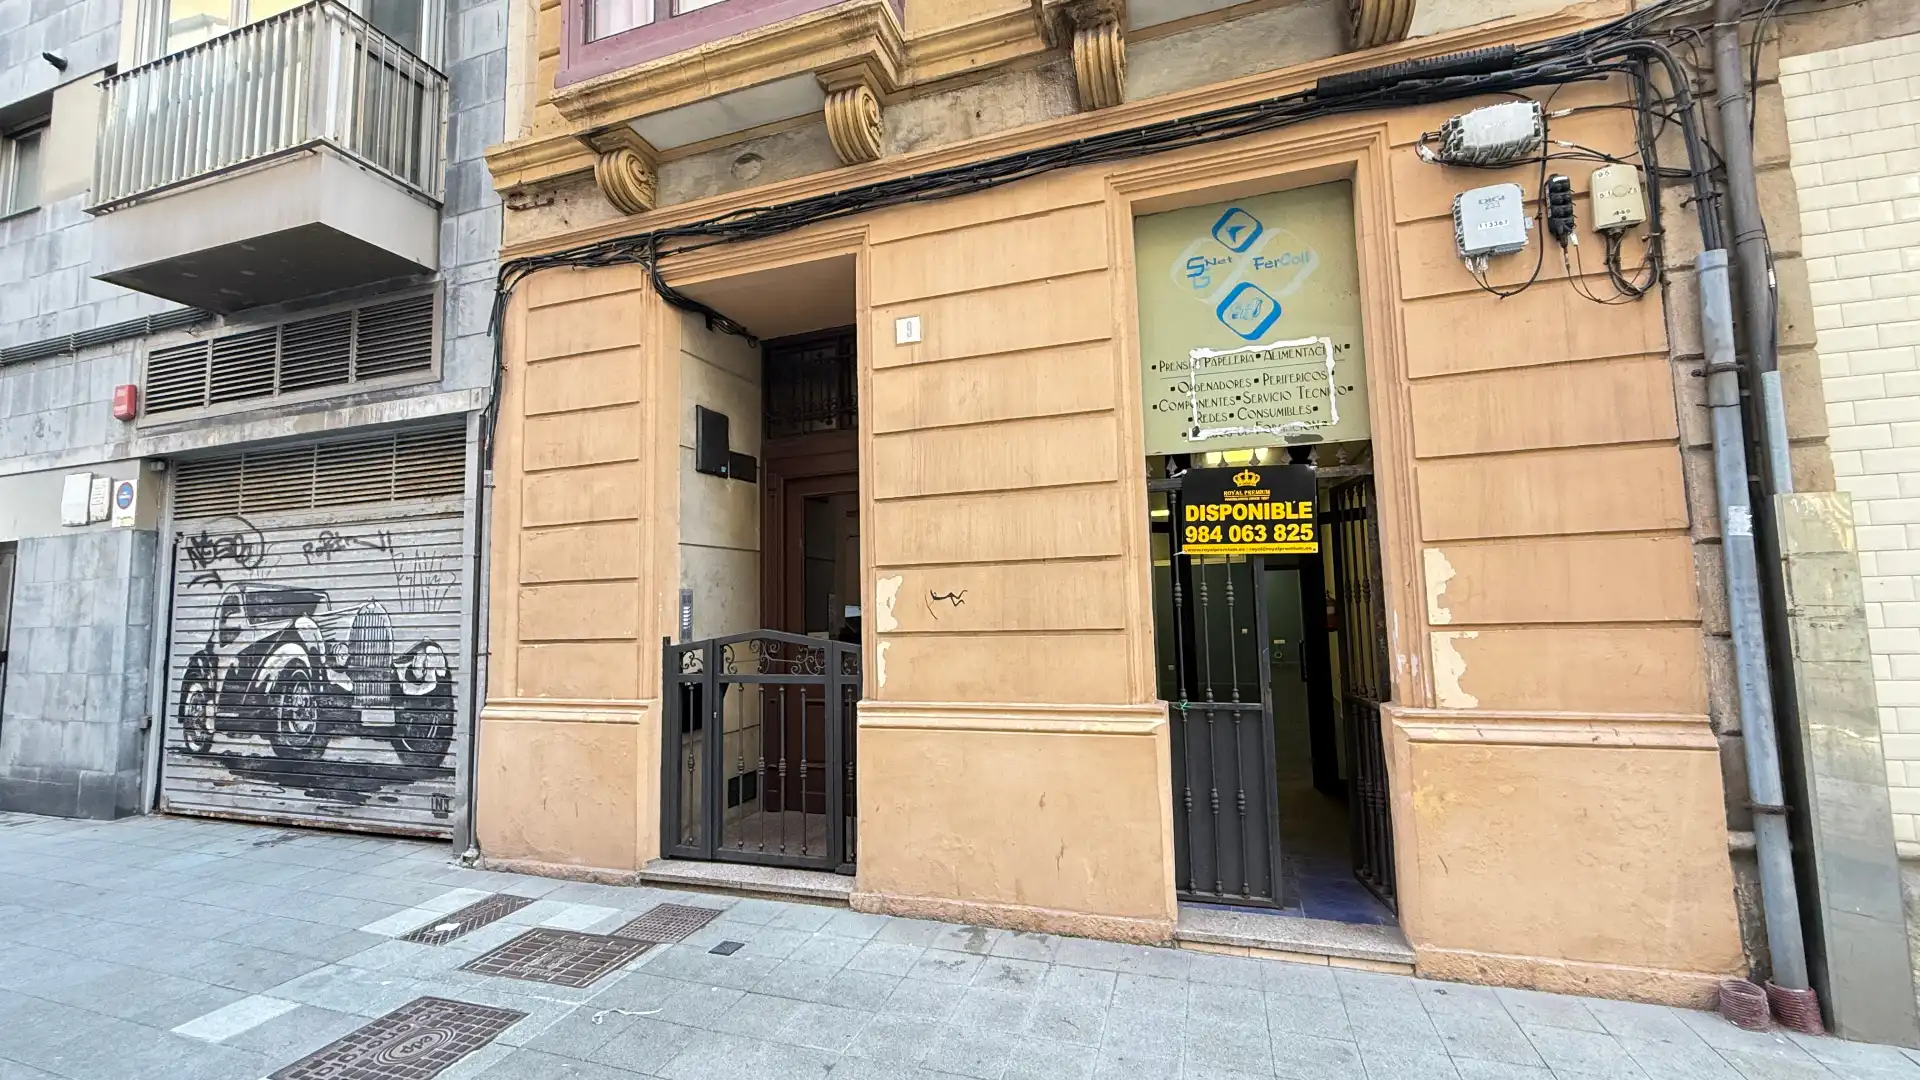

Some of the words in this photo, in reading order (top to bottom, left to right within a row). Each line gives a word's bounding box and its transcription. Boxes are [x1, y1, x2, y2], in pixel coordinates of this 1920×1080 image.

[906, 320, 913, 338] 9
[1263, 343, 1342, 361] ALIMENTACIN
[1243, 389, 1292, 405] SERVICIO
[1296, 384, 1348, 400] TECNIO
[1197, 410, 1228, 423] REDES
[1237, 403, 1312, 421] CONSUMIBLES
[1185, 501, 1313, 522] DISPONIBLE
[1185, 525, 1223, 543] 984
[1228, 524, 1267, 543] 063
[1273, 523, 1314, 542] 825
